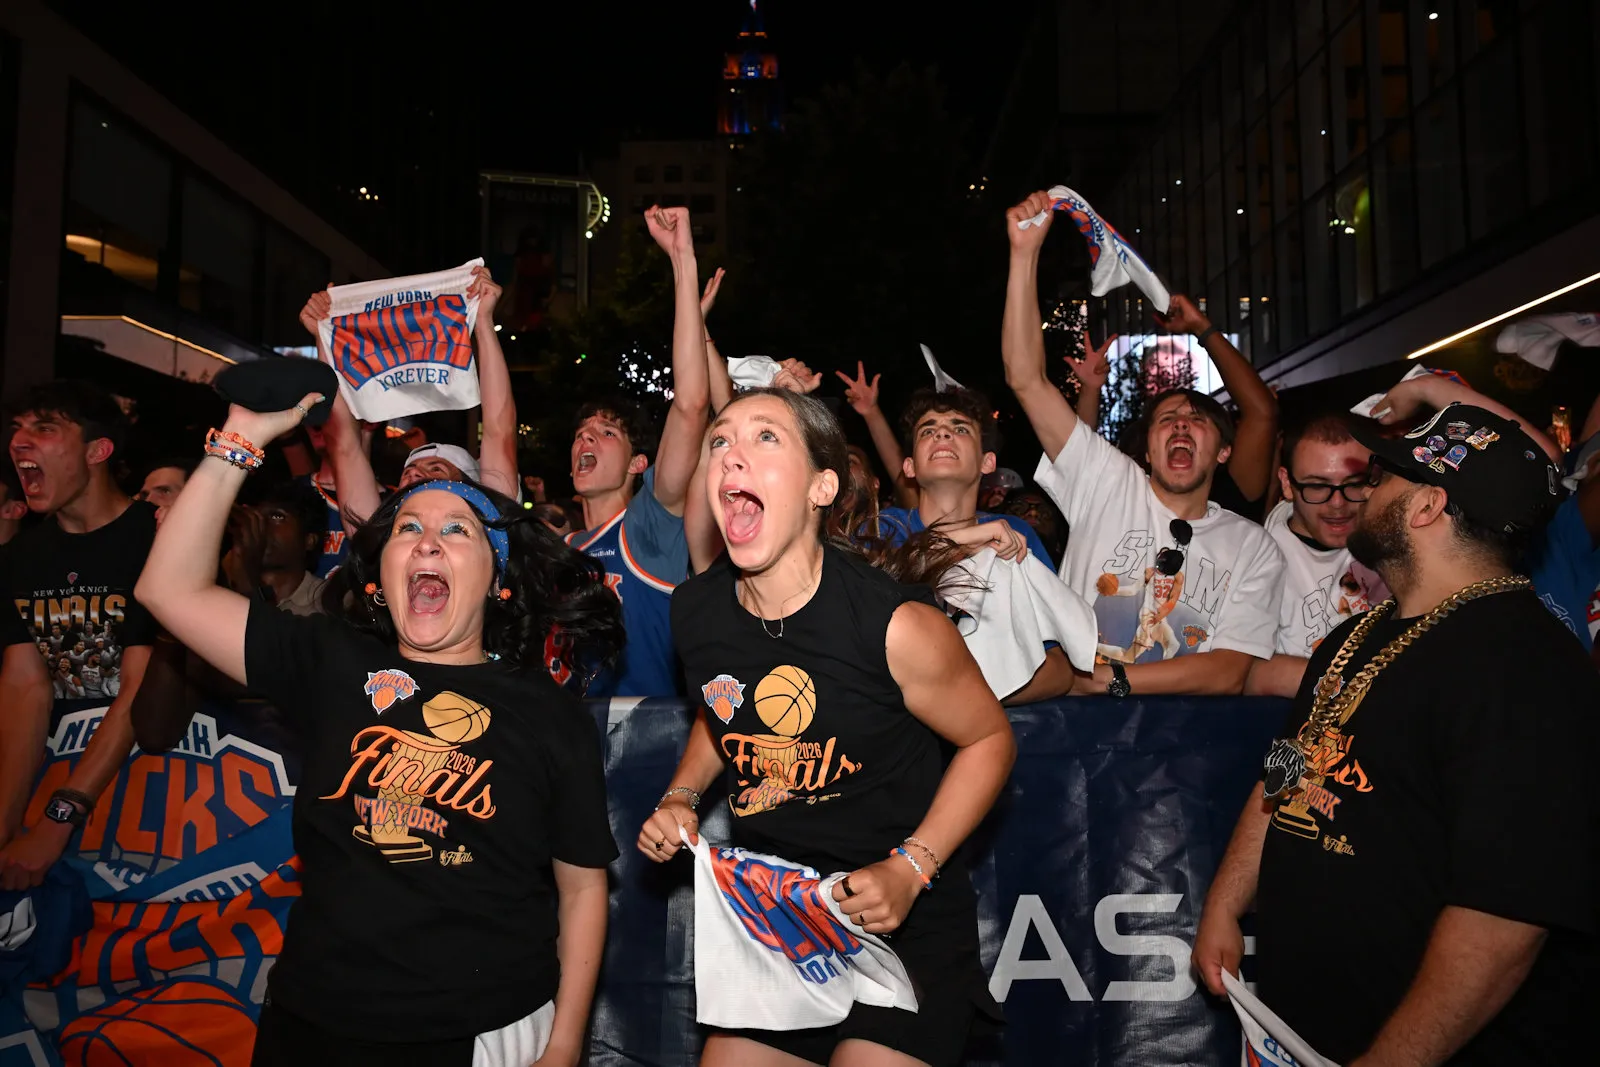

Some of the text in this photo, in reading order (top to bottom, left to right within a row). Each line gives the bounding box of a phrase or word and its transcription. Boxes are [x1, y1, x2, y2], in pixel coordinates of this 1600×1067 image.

[364, 290, 433, 313] NEW YORK
[33, 589, 55, 598] NEW
[1102, 529, 1231, 629] SM
[1154, 585, 1171, 599] 32
[366, 671, 414, 695] KNICKS
[705, 680, 743, 702] KNICKS
[57, 716, 104, 752] NE
[447, 750, 476, 776] 2026
[721, 733, 863, 792] Finals
[797, 742, 823, 760] 2026
[318, 725, 497, 820] Finals
[22, 752, 277, 860] ICKS
[1304, 783, 1342, 822] YORK
[394, 804, 449, 839] YORK
